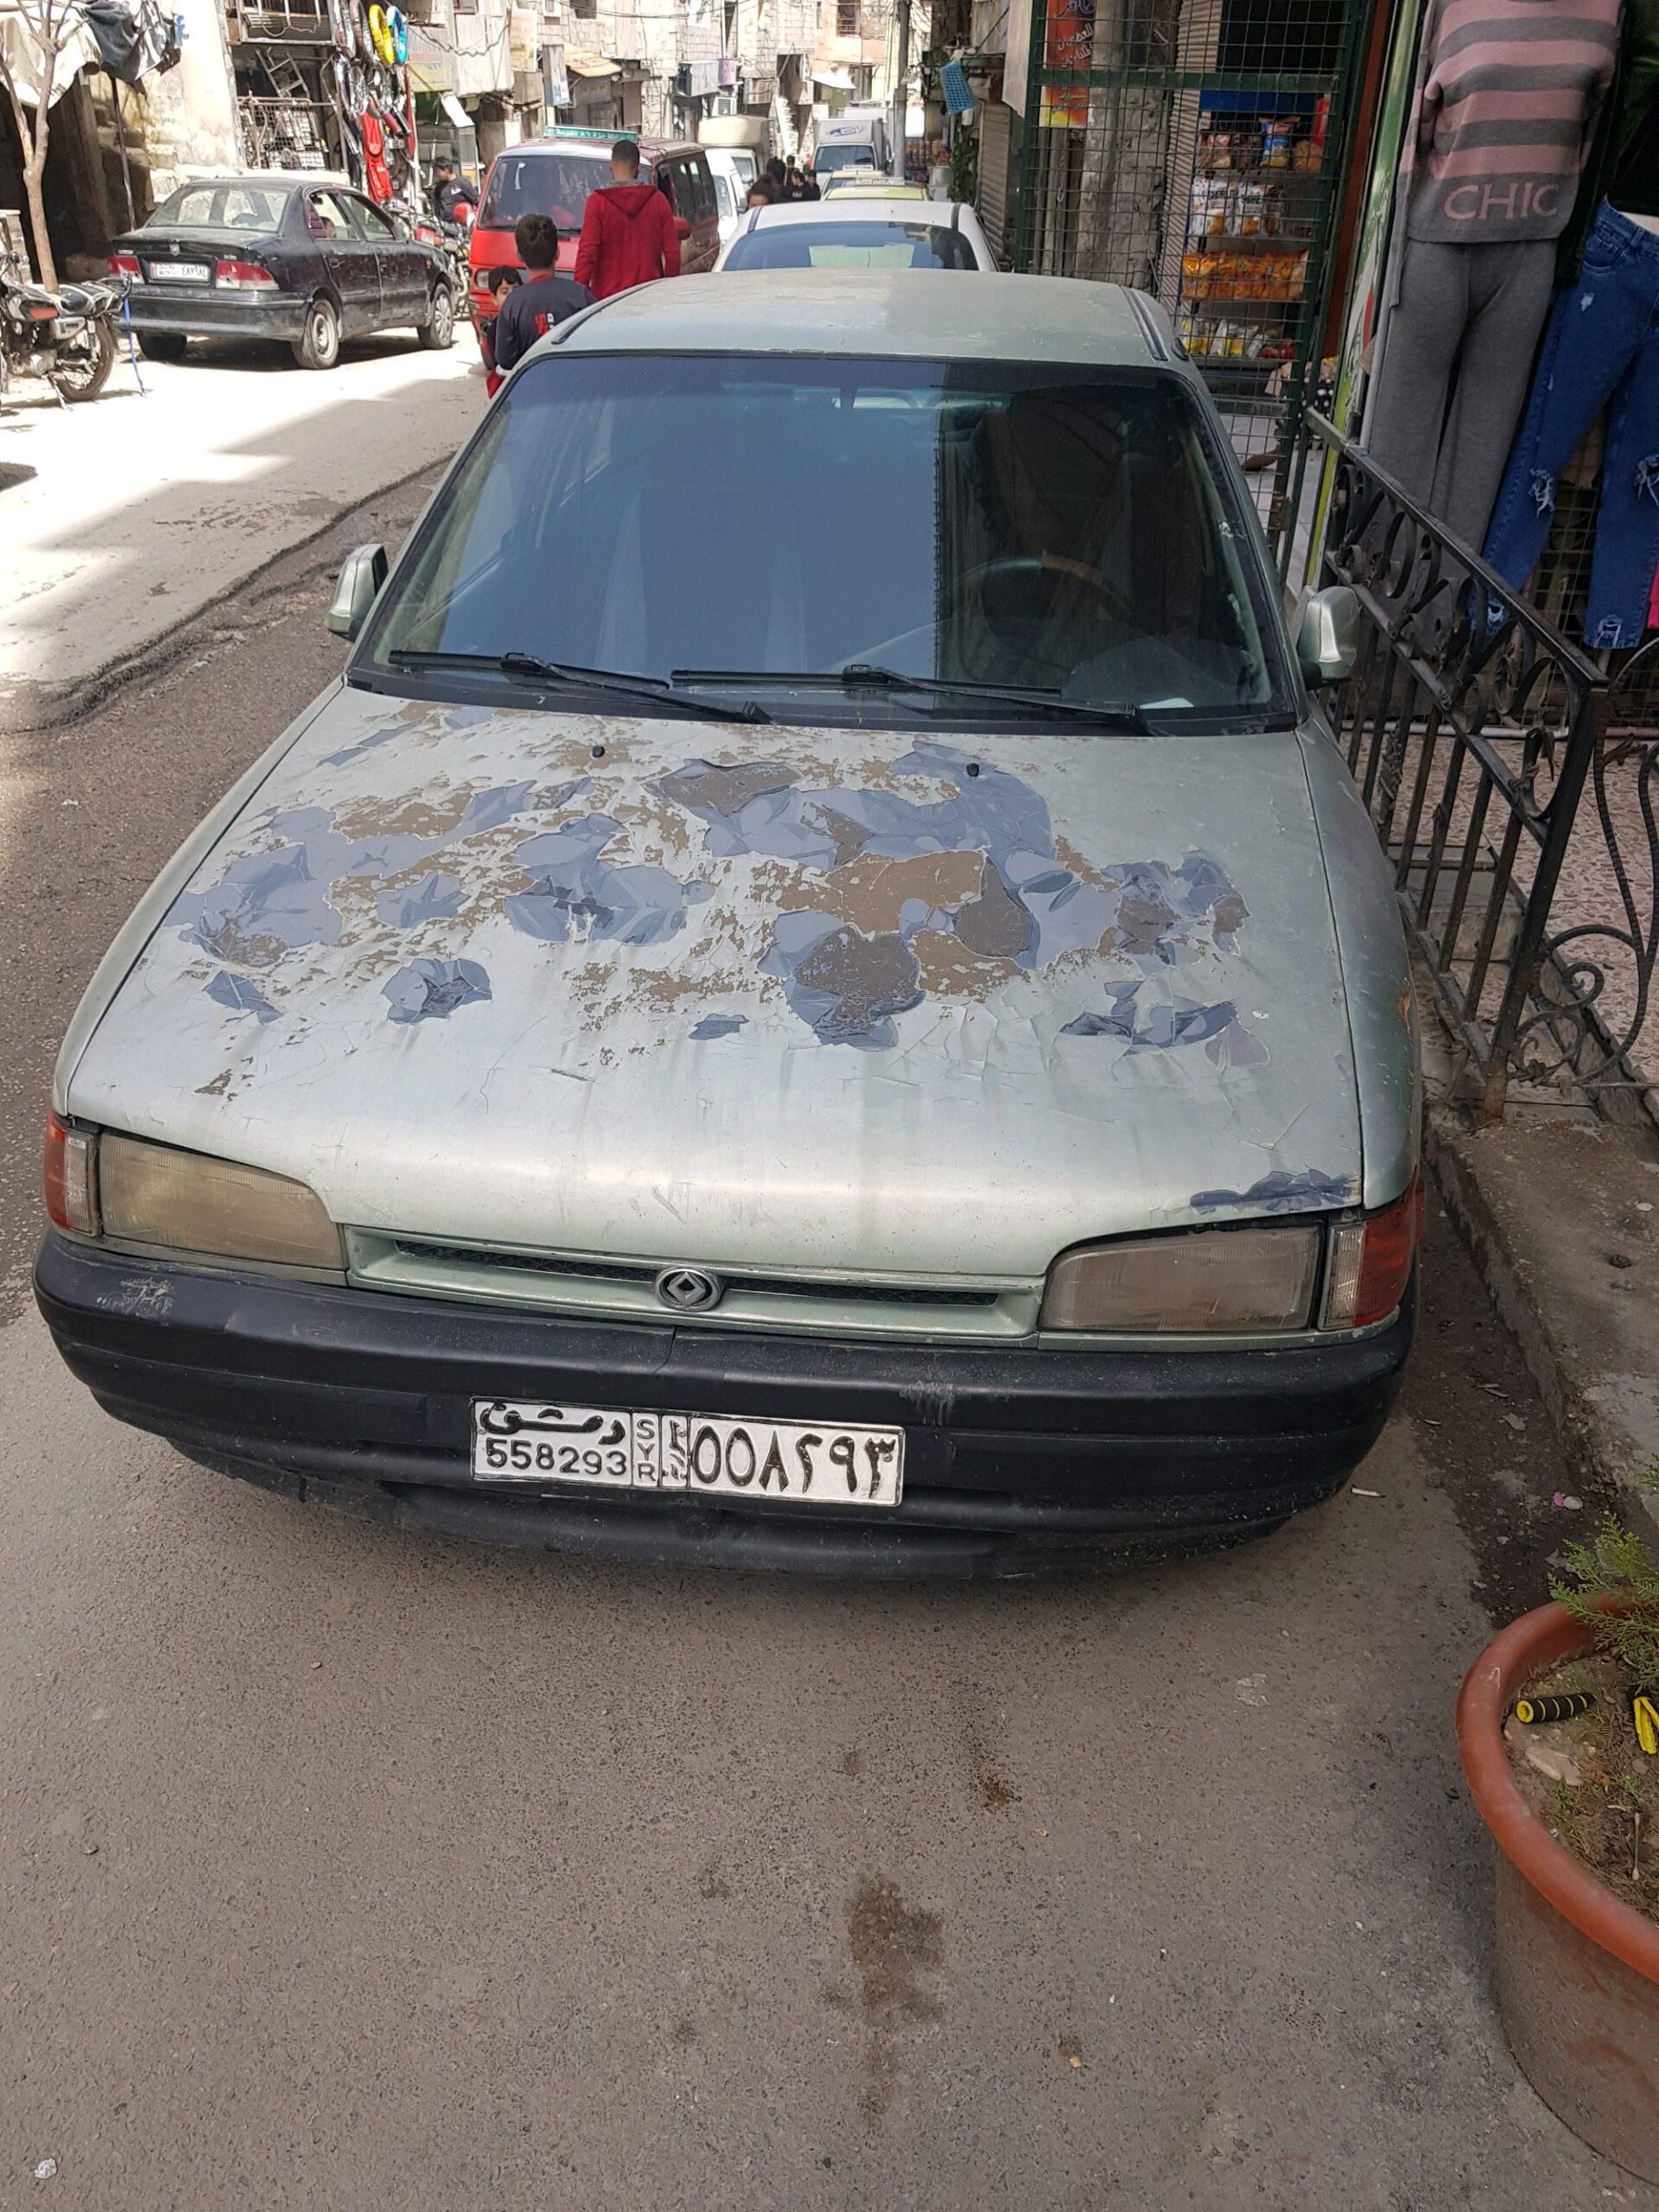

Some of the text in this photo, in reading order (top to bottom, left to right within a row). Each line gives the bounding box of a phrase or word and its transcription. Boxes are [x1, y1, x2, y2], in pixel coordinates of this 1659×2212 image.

[1444, 181, 1560, 220] CHIC
[480, 1402, 626, 1446] دمشق
[486, 1436, 627, 1476] 558293
[636, 1419, 657, 1482] SYR
[690, 1424, 897, 1499] ٥٥٨٢٩٣
